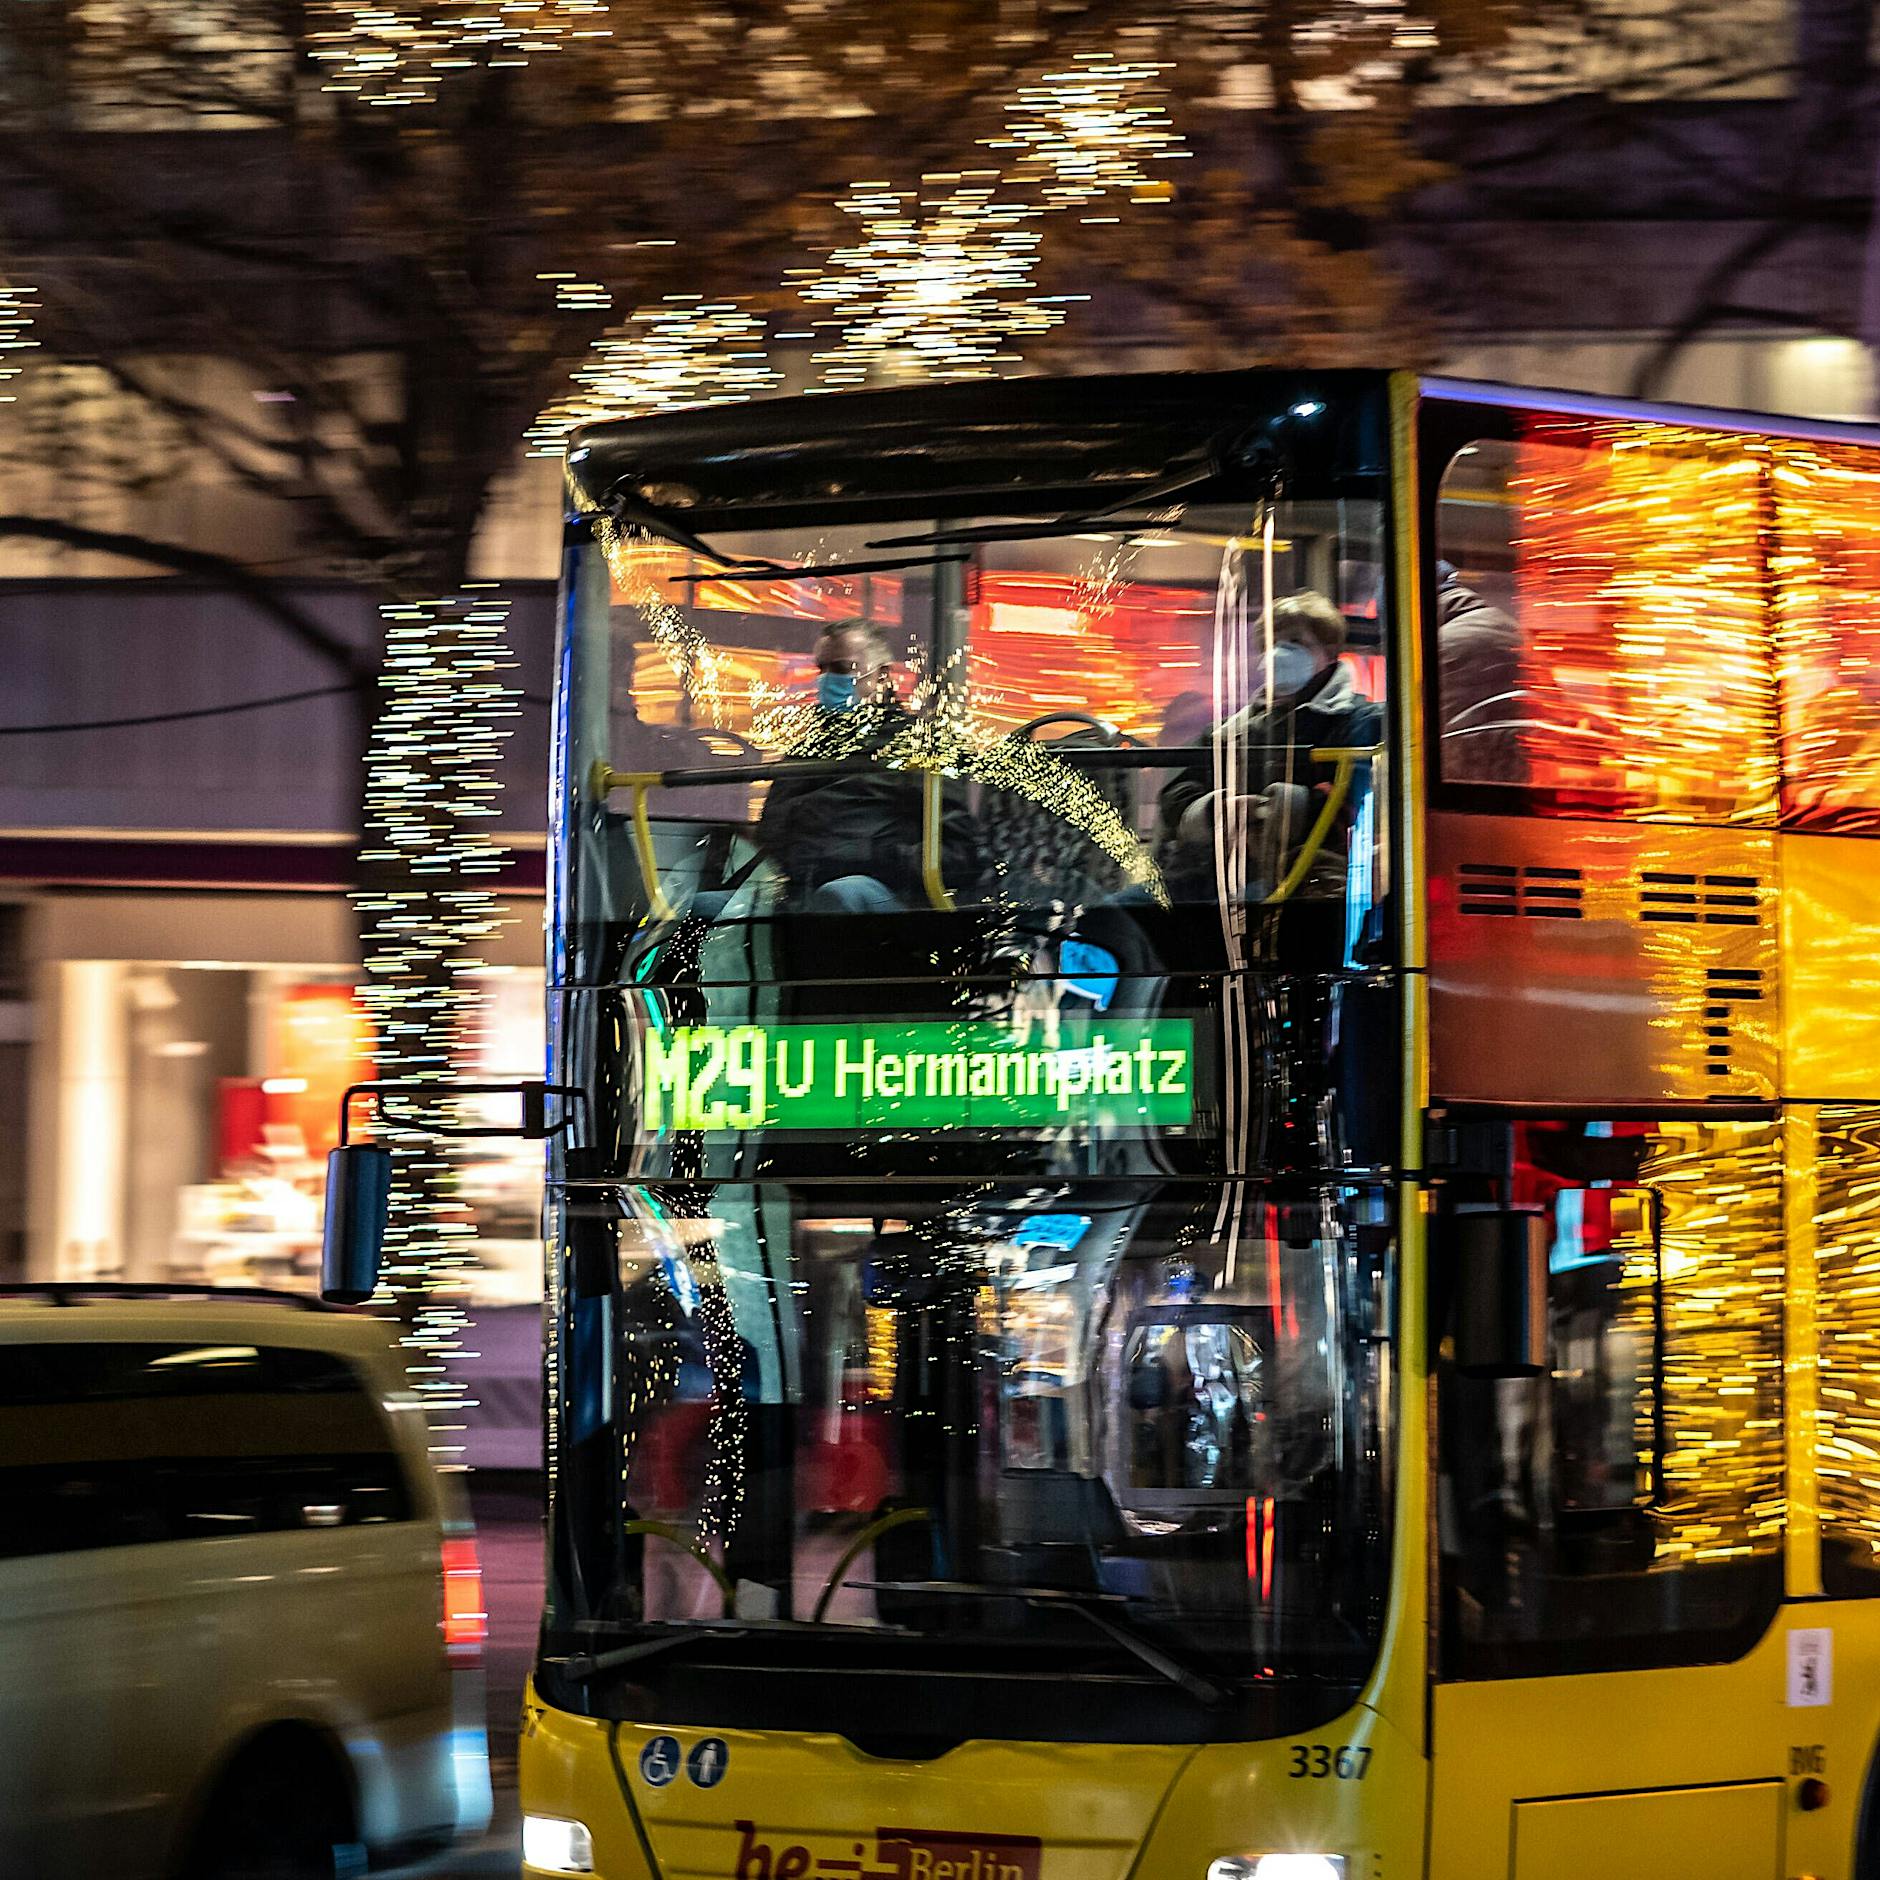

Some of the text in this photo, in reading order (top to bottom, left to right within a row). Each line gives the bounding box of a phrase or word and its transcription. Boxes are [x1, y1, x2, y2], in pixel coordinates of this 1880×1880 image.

[644, 1025, 1187, 1130] M29 U Hermannplatz
[1288, 1745, 1374, 1780] 3367
[909, 1847, 1024, 1880] Berlin
